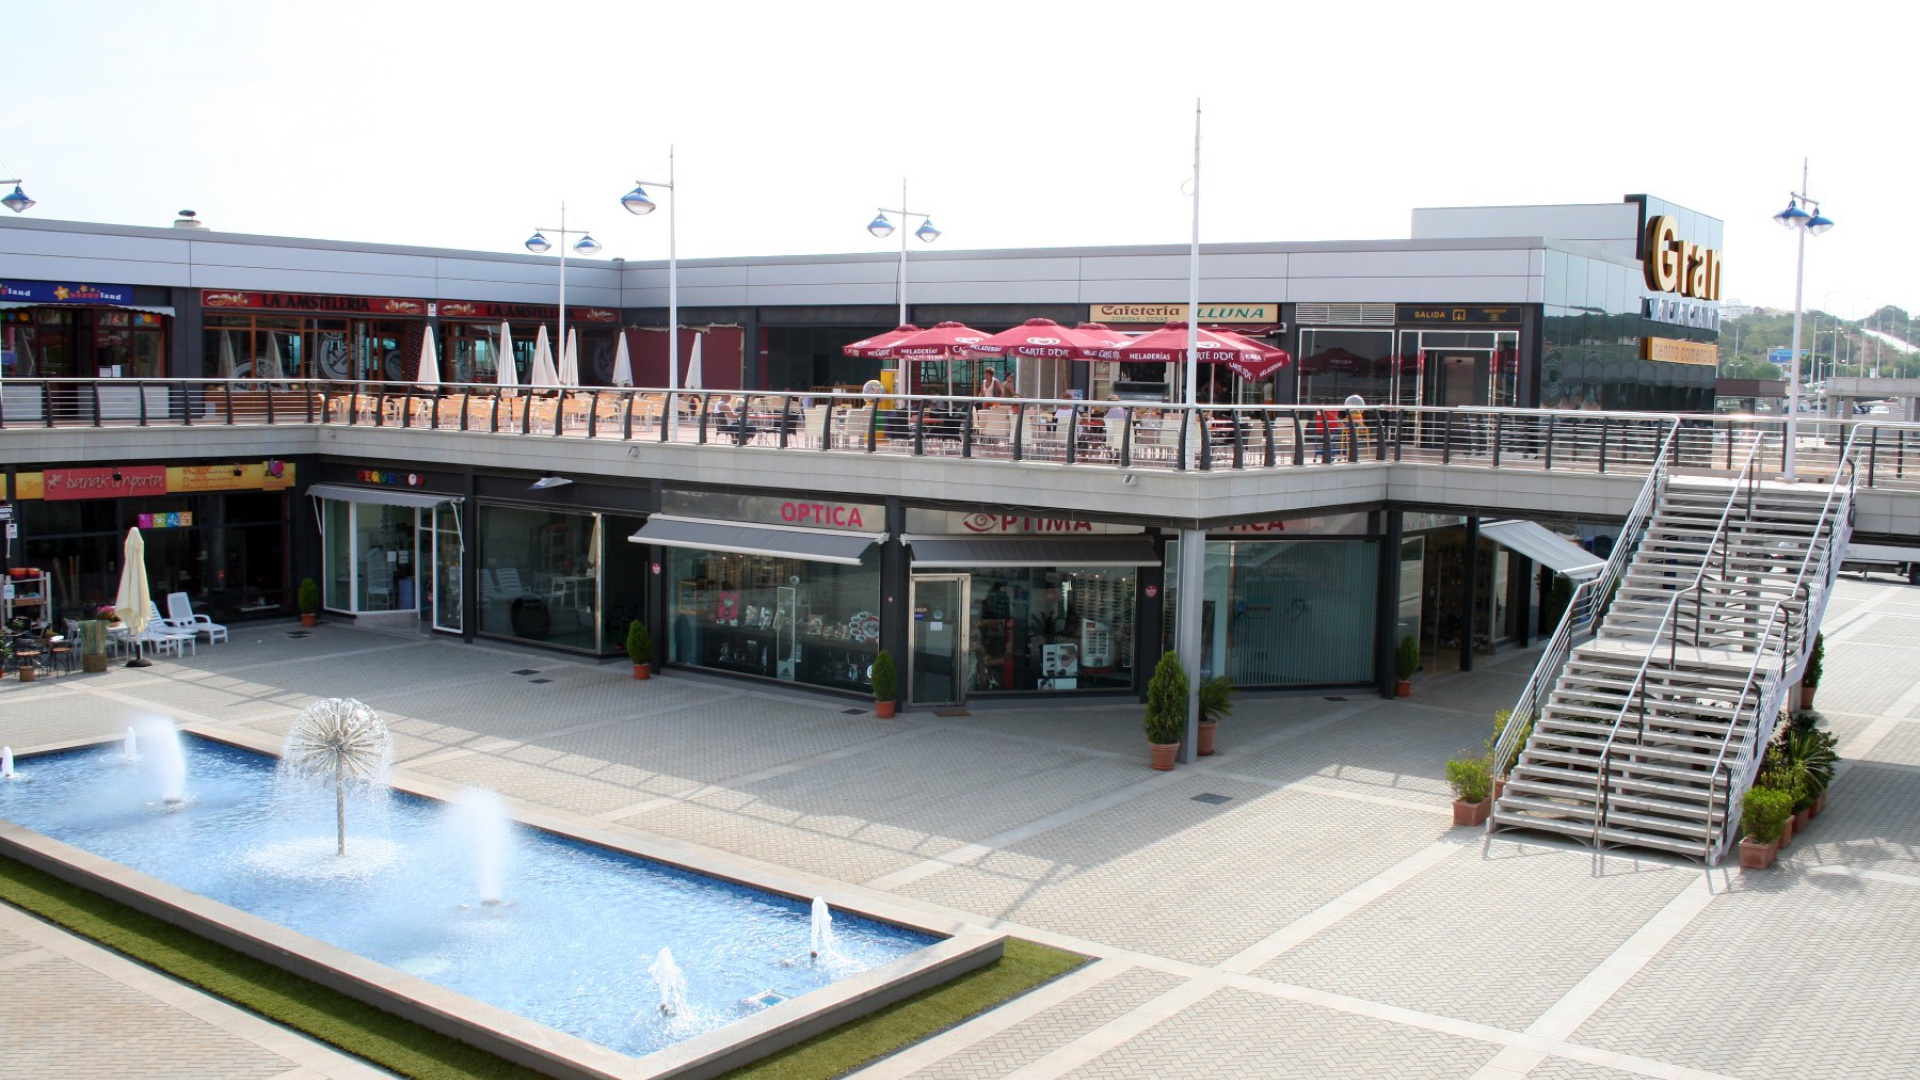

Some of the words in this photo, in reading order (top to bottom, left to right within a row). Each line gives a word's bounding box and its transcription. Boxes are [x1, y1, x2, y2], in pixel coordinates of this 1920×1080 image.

[1648, 214, 1721, 300] Gran
[263, 294, 281, 308] LA
[286, 295, 370, 311] AMSTELERIA
[1414, 311, 1446, 319] SALIDA
[1019, 346, 1045, 355] CARTE
[781, 502, 863, 528] OPTICA
